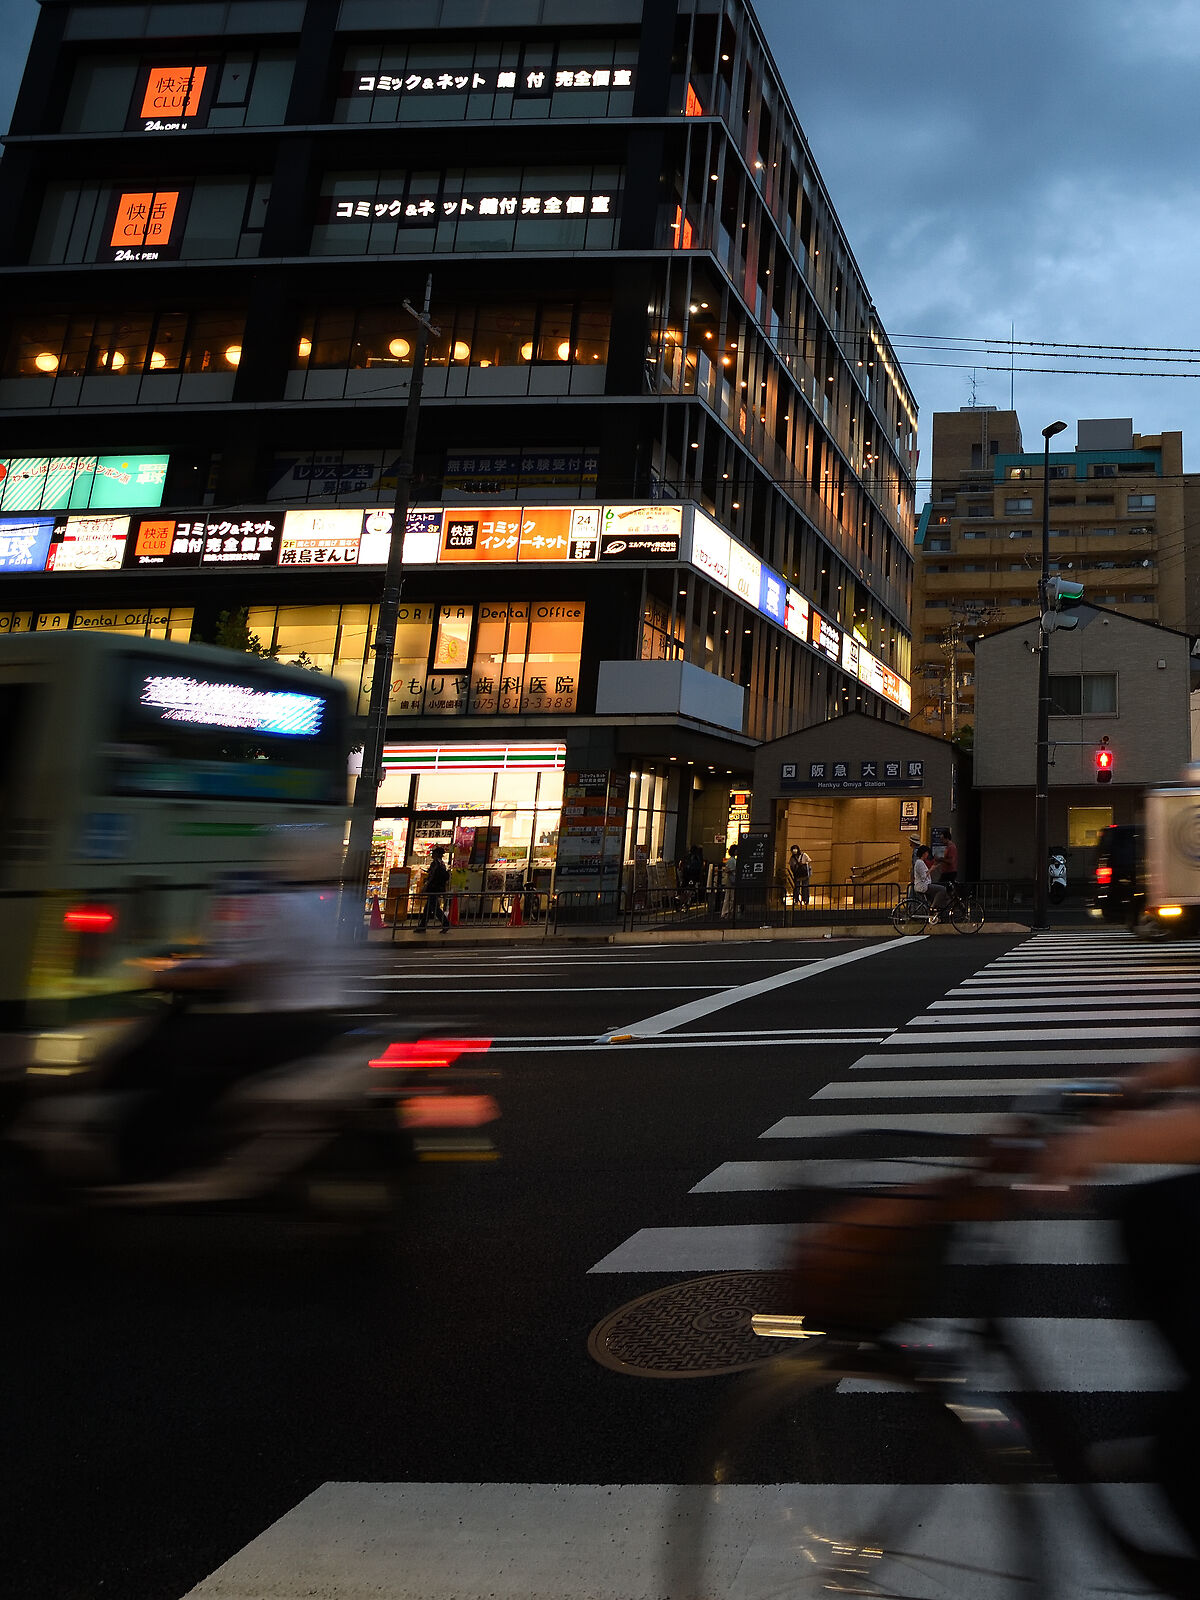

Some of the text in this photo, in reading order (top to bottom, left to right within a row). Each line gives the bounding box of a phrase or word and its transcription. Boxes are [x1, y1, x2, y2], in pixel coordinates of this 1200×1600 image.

[156, 77, 196, 93] 快活
[359, 72, 486, 91] コミック&ネット
[127, 203, 167, 221] 快活
[336, 199, 475, 218] コミック&ネット
[124, 223, 162, 237] CLUB
[481, 520, 536, 534] コミック
[577, 516, 591, 525] 24
[144, 527, 169, 540] 快活
[176, 521, 276, 536] コミック&ネット
[450, 525, 474, 537] 快活
[142, 541, 167, 550] CLUB
[450, 536, 473, 546] CLUB
[480, 535, 568, 549] インターネット
[281, 549, 356, 564] 焼鳥ぎんじ
[574, 549, 591, 559] 5F
[73, 614, 118, 626] Dental
[125, 613, 169, 625] Office
[481, 606, 530, 619] Dental
[537, 606, 581, 618] Office
[407, 676, 574, 695] もりや歯科医院
[400, 700, 420, 710] 歯科
[811, 762, 922, 778] 阪急大宮駅
